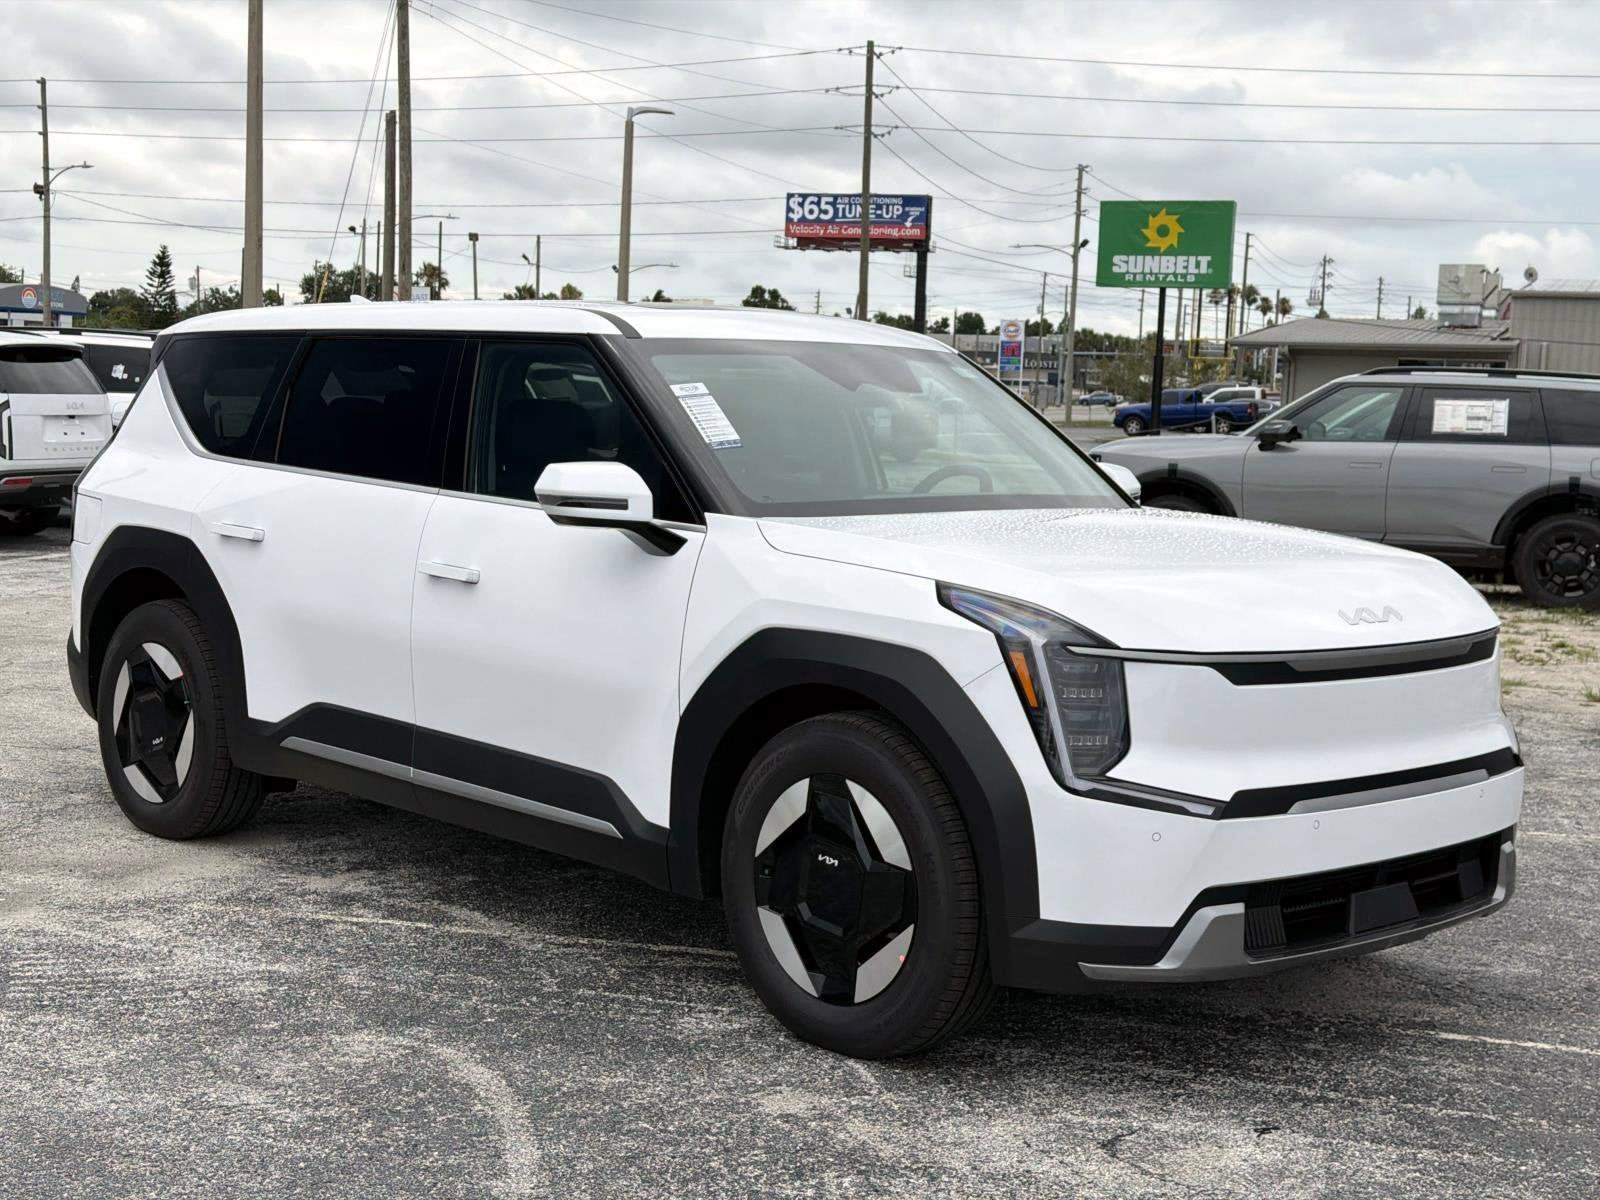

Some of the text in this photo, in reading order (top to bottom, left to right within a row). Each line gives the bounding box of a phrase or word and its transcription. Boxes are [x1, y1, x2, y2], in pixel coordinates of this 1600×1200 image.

[836, 196, 903, 205] AIR COITIONING
[789, 195, 834, 222] $65
[836, 204, 903, 219] TUNE-UP
[789, 224, 920, 237] Velocity Air Conioning.com
[1125, 273, 1196, 282] RENTALS
